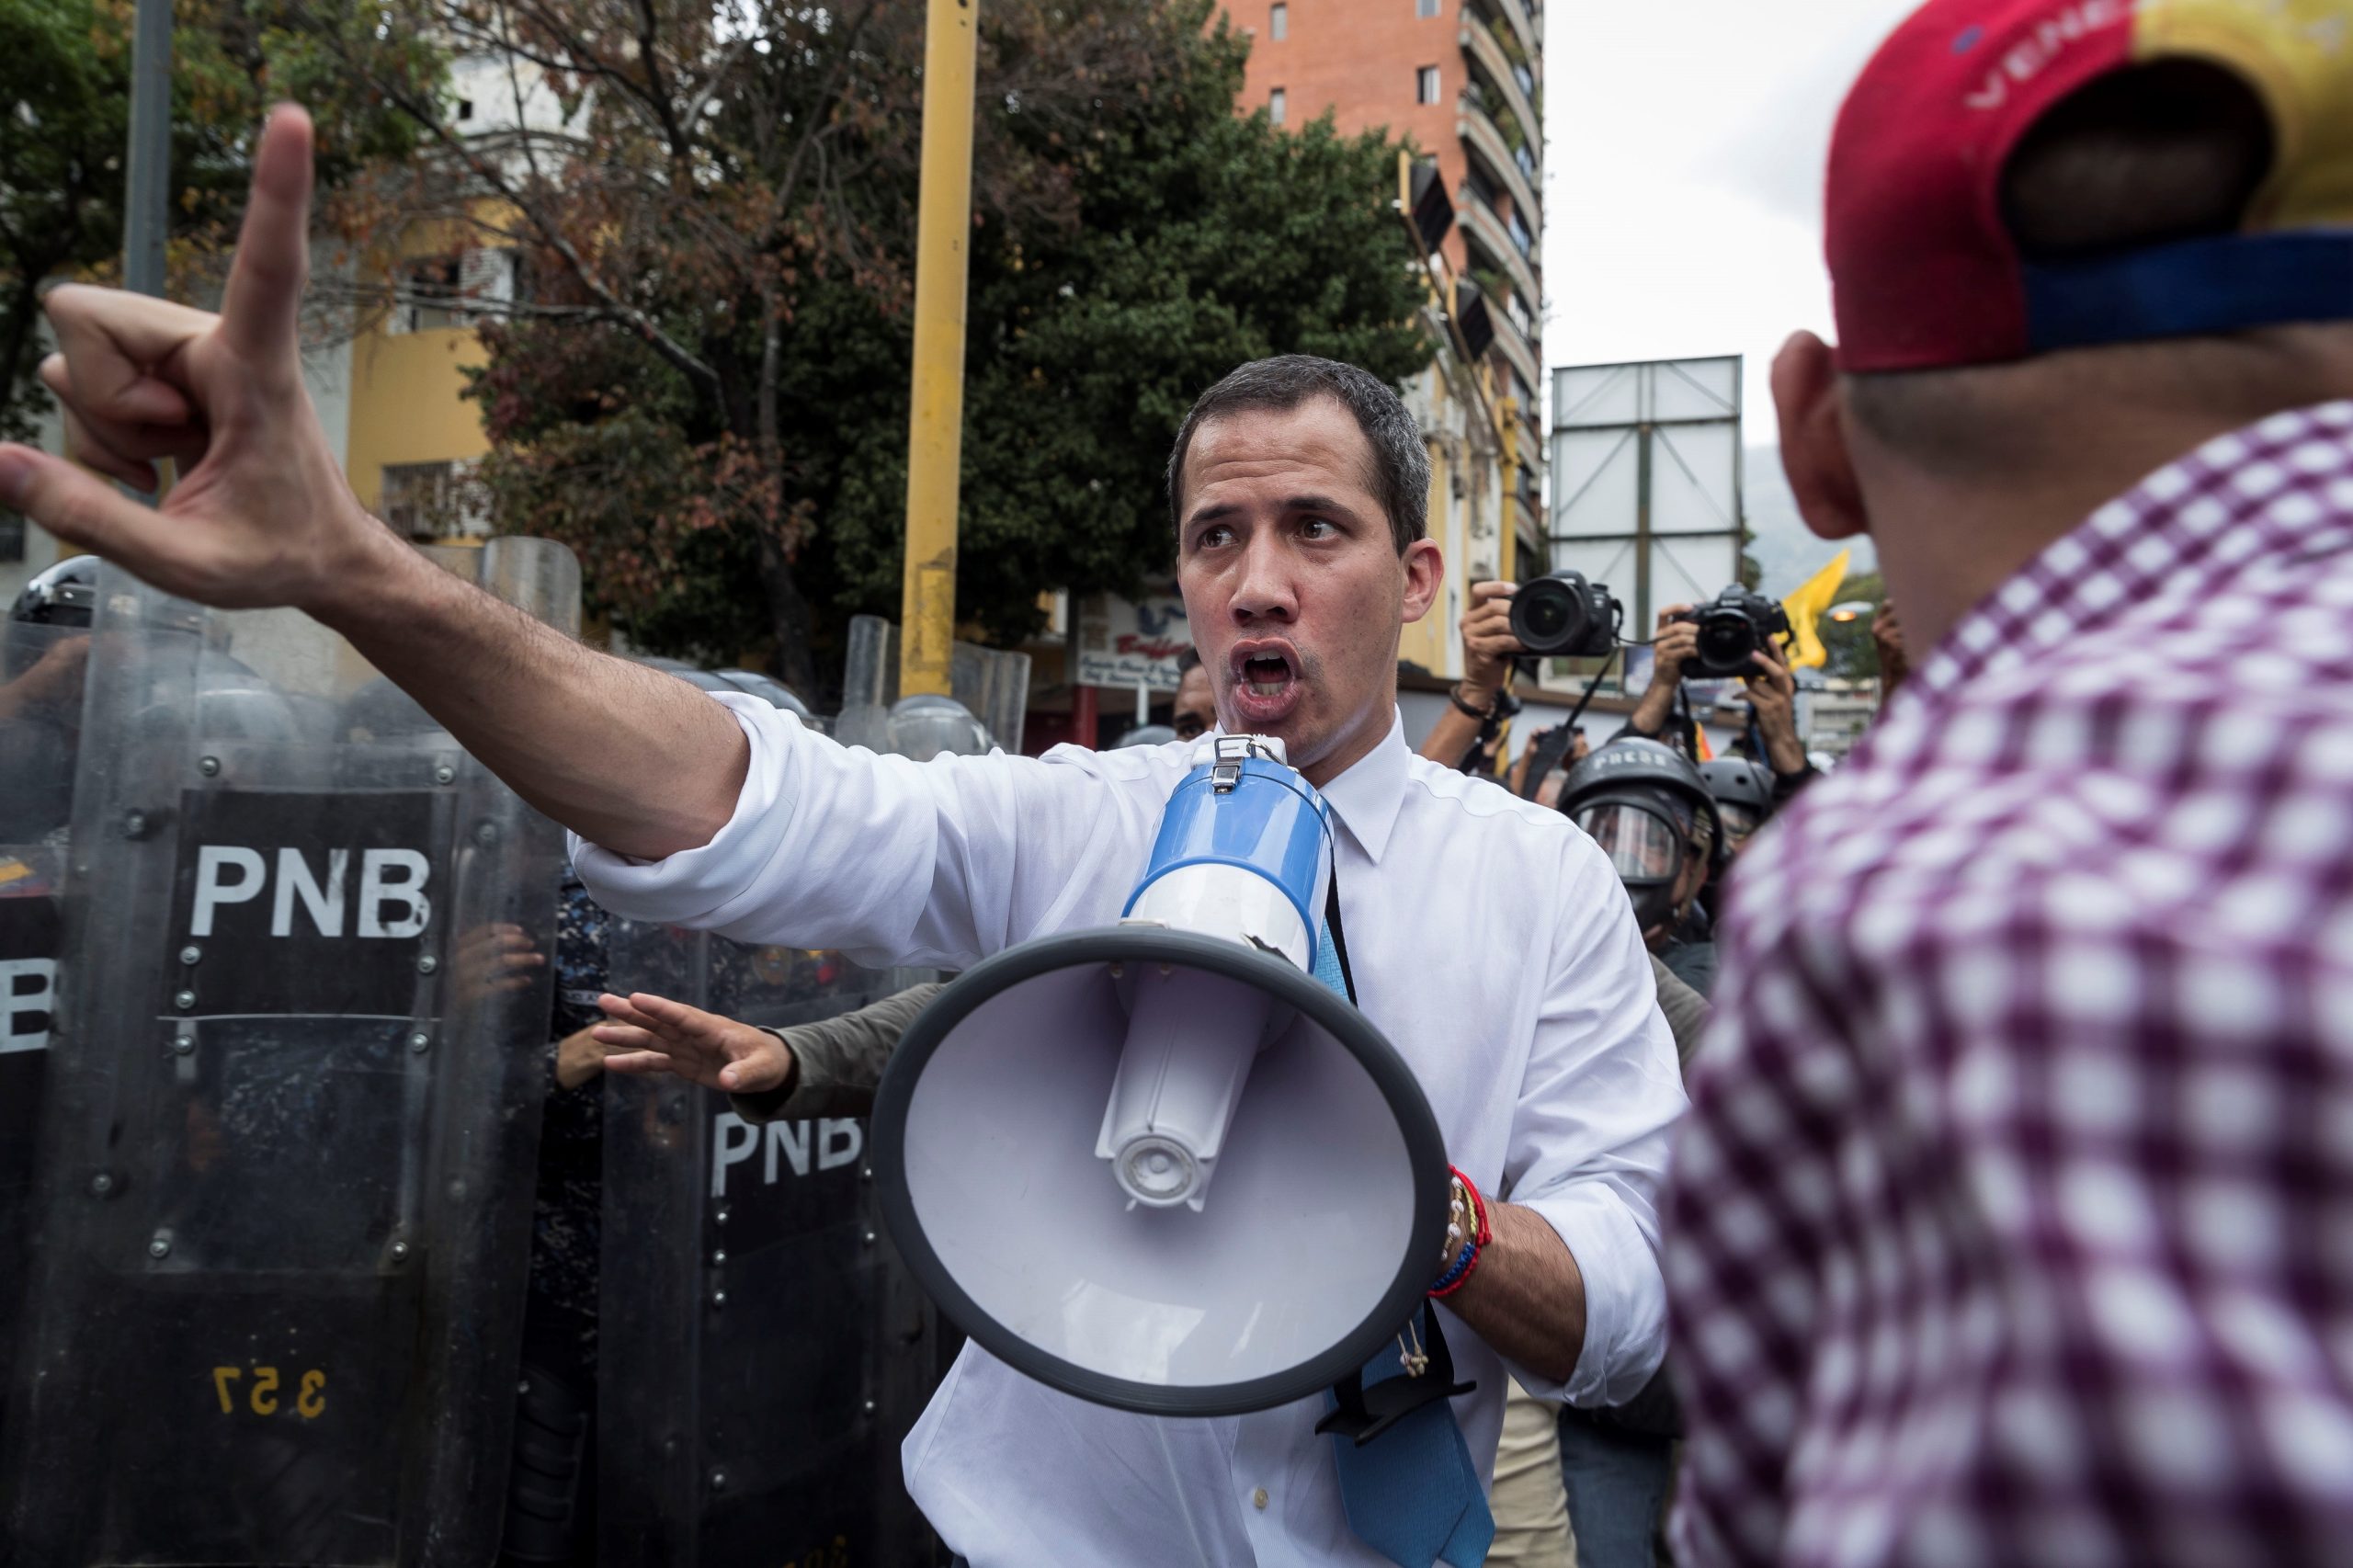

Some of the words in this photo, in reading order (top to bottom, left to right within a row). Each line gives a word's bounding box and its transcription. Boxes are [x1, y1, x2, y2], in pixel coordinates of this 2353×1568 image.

[1965, 0, 2128, 108] VENE
[191, 846, 431, 937] PNB
[712, 1112, 862, 1198] PNB
